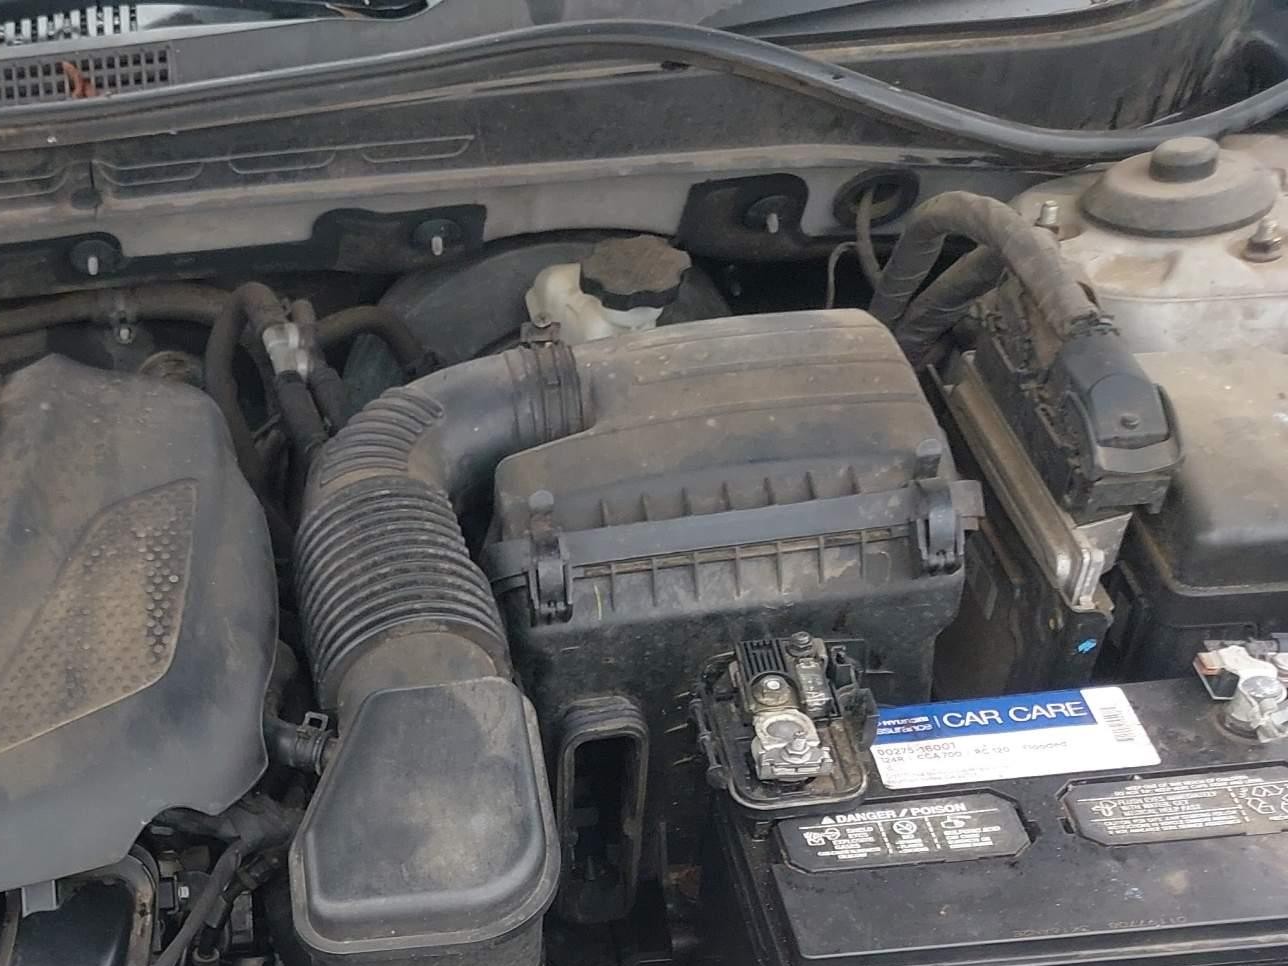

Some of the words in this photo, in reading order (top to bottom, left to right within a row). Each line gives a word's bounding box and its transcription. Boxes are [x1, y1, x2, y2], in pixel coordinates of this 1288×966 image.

[942, 706, 1004, 728] CAR
[1008, 701, 1088, 722] CARE
[835, 809, 897, 823] DANGER
[910, 802, 967, 817] POISON
